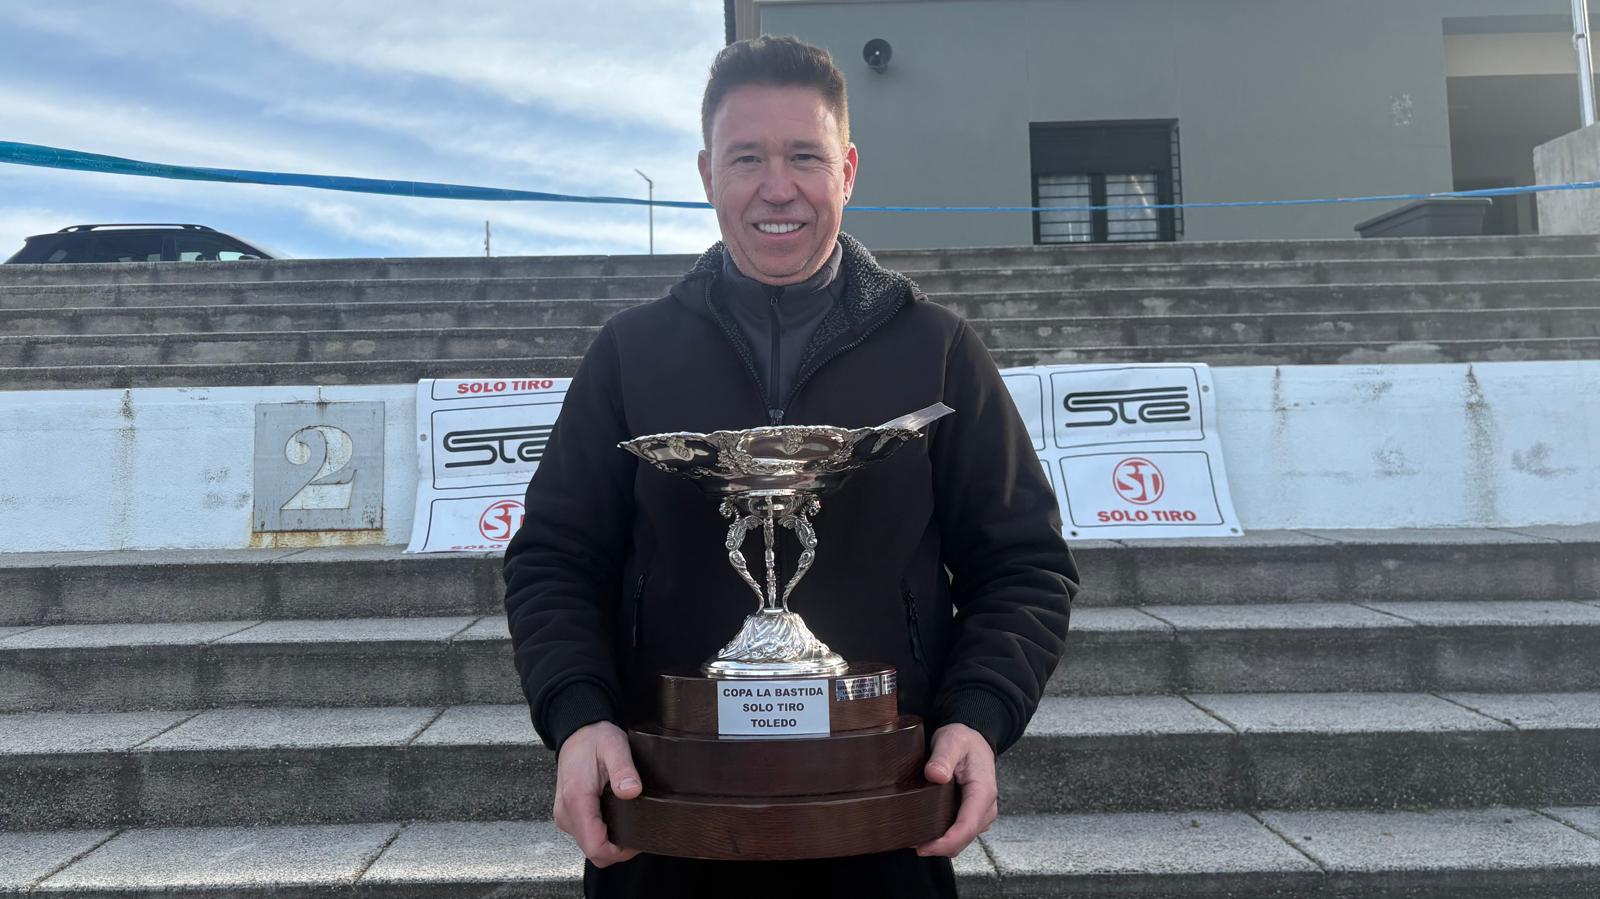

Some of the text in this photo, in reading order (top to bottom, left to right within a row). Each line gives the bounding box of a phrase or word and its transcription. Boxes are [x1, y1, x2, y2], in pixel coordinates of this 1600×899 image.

[457, 379, 553, 394] SOLO TIRO
[280, 424, 358, 511] 2
[1114, 460, 1161, 503] ST
[1097, 509, 1197, 522] SOLO TIRO
[723, 687, 824, 697] COPA LA BASTIDA
[742, 702, 805, 712] SOLO TIRO
[750, 718, 797, 728] TOLEDO
